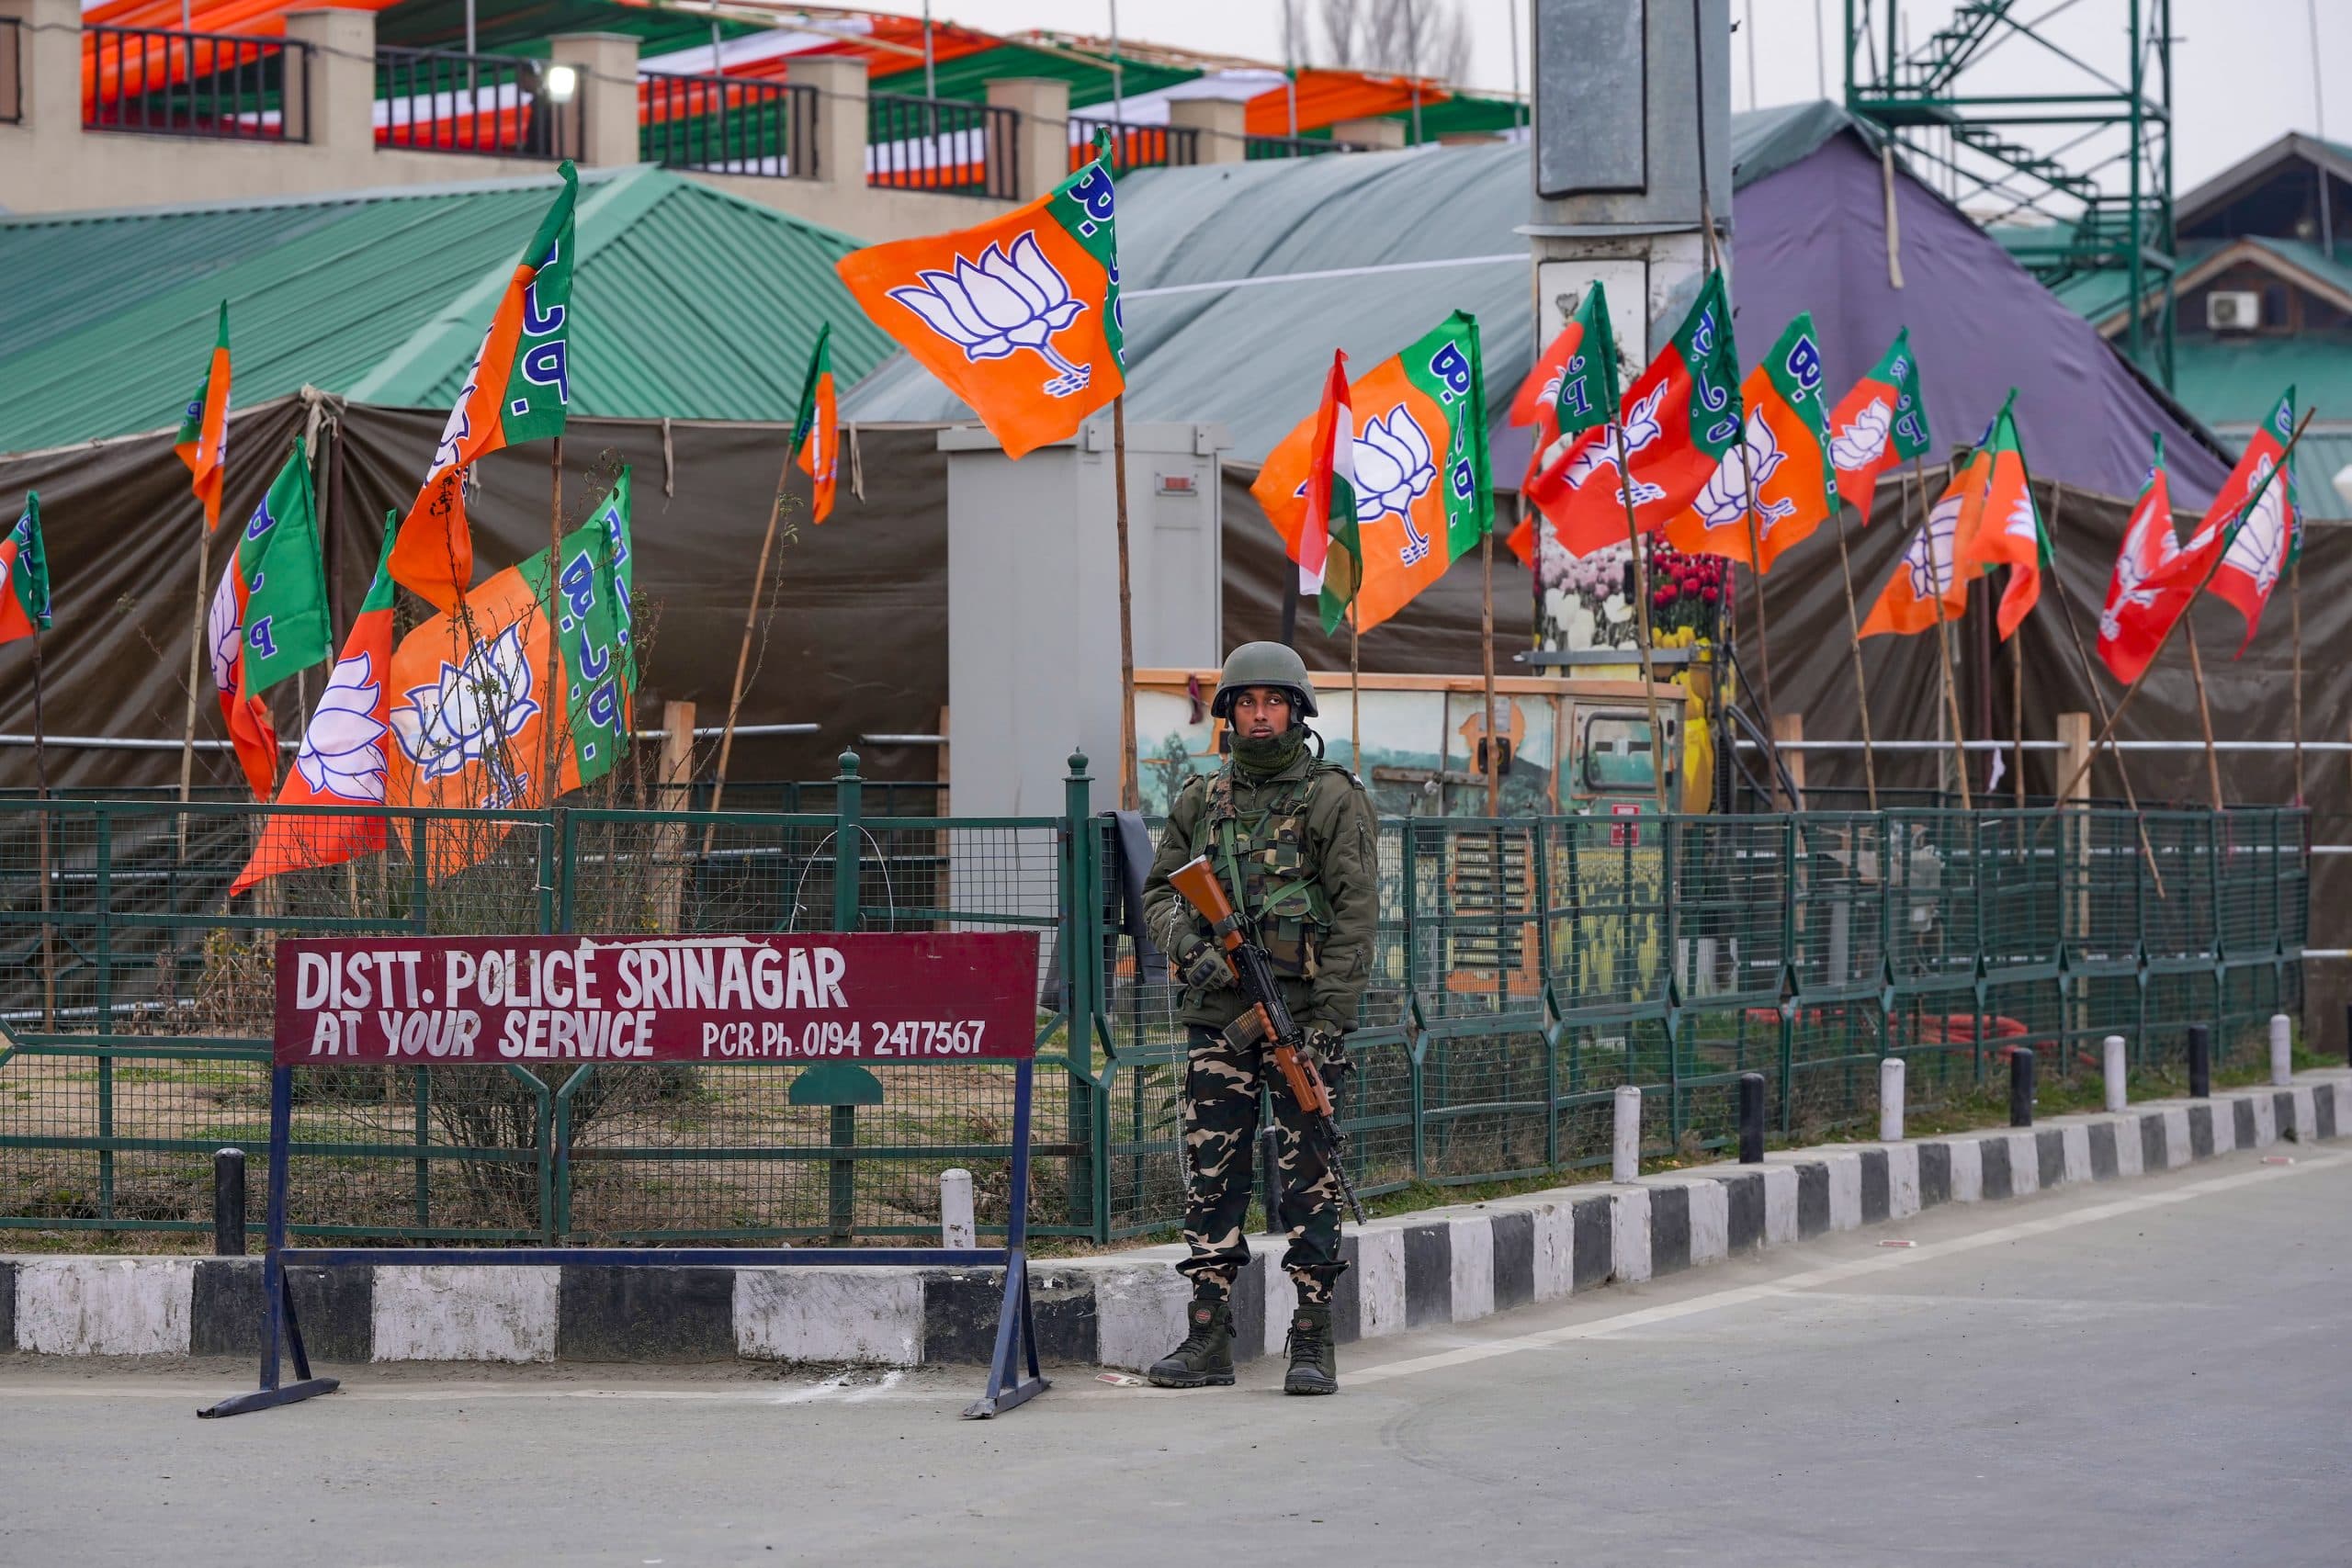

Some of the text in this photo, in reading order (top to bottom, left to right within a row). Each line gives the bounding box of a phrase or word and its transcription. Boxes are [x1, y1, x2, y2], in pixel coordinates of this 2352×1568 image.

[296, 947, 849, 1010] DISTT. POLICE SRINAGAR
[309, 1009, 657, 1057] AT YOUR SERVICE
[872, 1020, 986, 1056] 2477567
